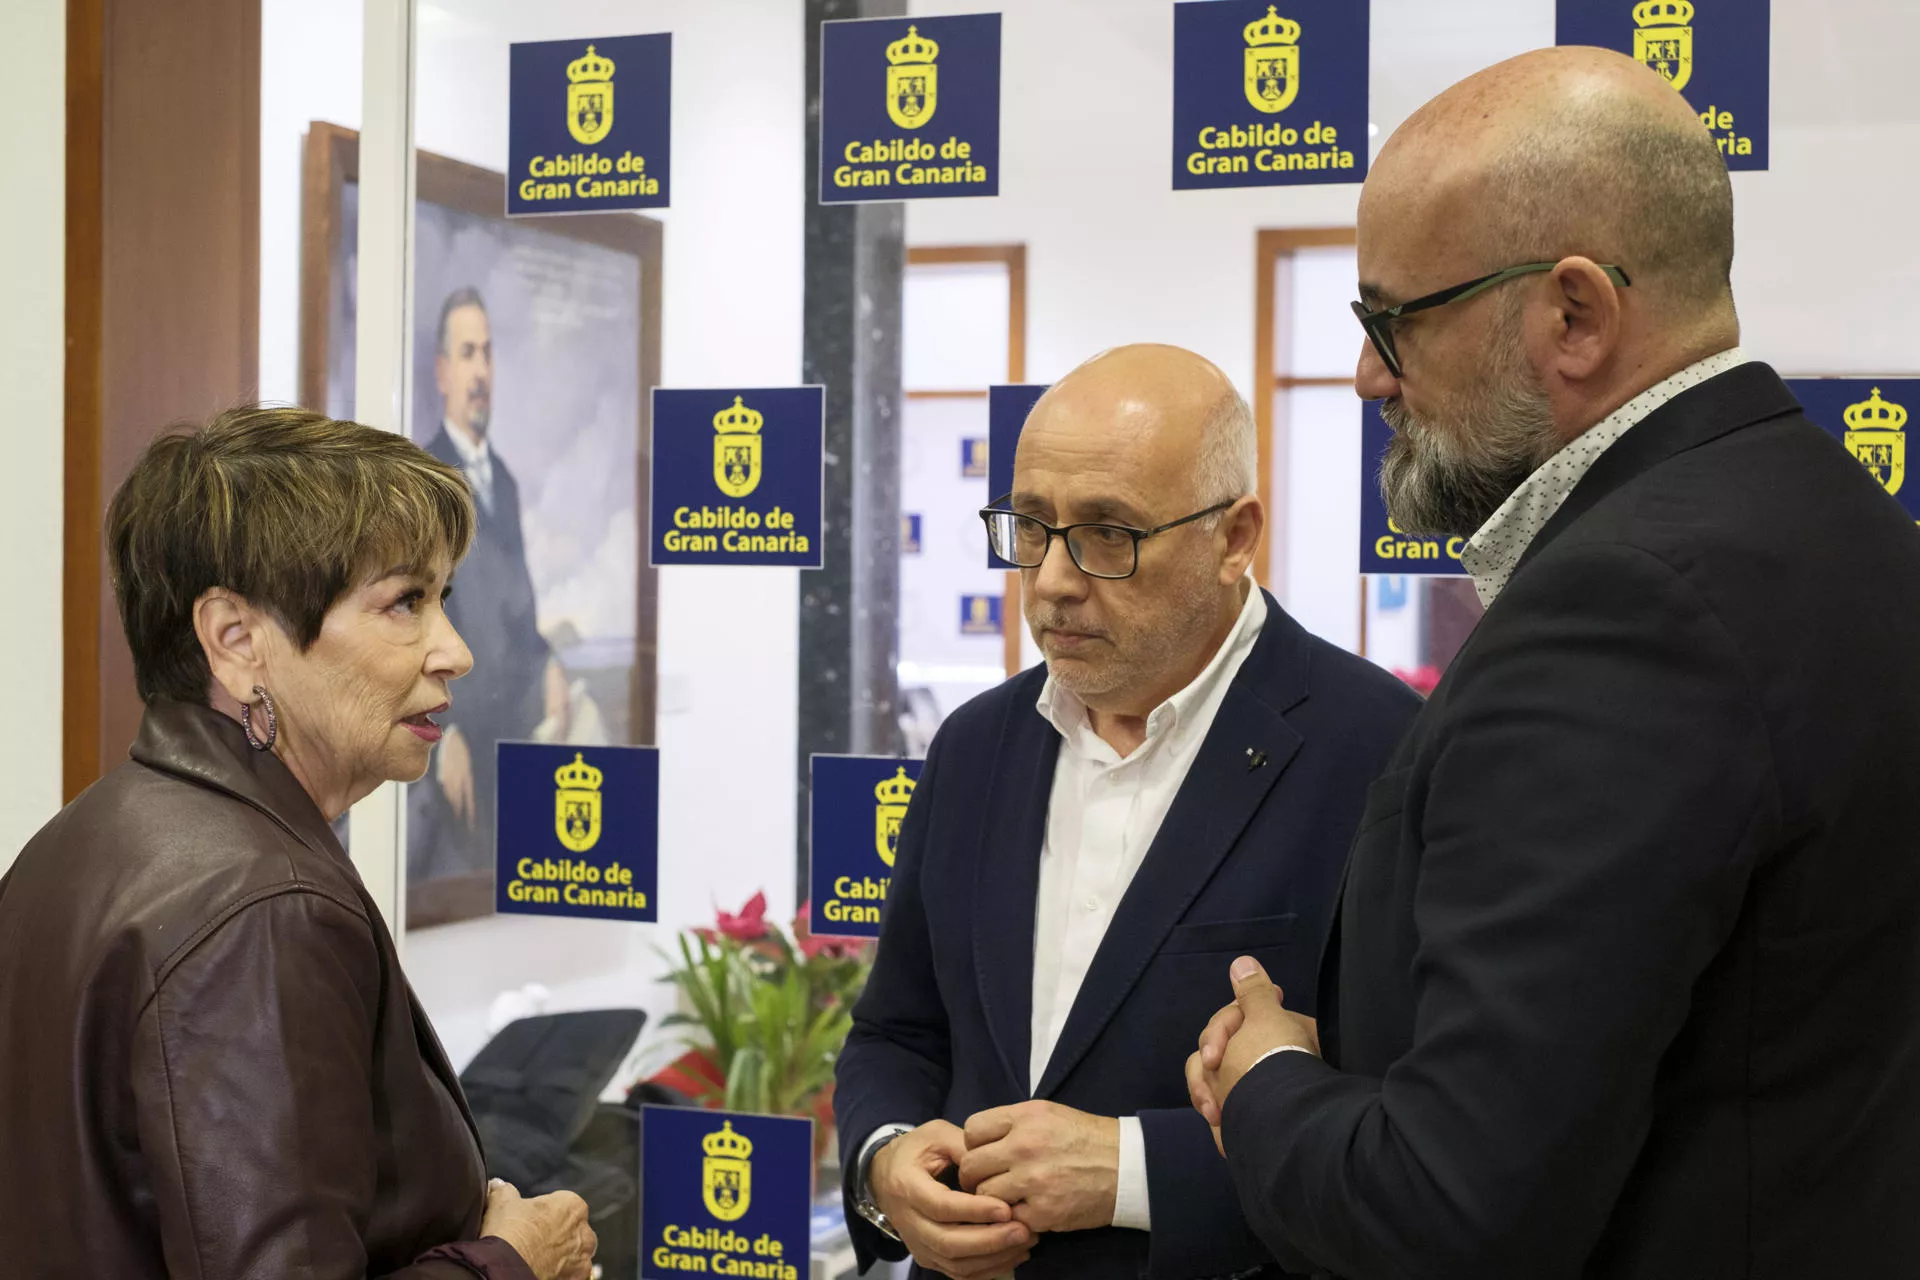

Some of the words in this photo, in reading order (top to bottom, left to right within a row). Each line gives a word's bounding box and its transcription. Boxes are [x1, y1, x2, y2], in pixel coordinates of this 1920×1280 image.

[1699, 105, 1733, 129] de
[1199, 122, 1298, 149] Cabildo
[1303, 121, 1337, 145] de
[844, 138, 936, 163] Cabildo
[940, 136, 971, 159] de
[1187, 152, 1248, 175] Gran
[1255, 145, 1354, 172] Canaria
[529, 152, 613, 177] Cabildo
[616, 151, 645, 173] de
[834, 166, 890, 187] Gran
[895, 160, 986, 185] Canaria
[519, 179, 571, 200] Gran
[575, 173, 659, 198] Canaria
[674, 506, 760, 529] Cabildo
[765, 506, 794, 529] de
[664, 530, 717, 552] Gran
[722, 530, 809, 552] Canaria
[1375, 536, 1439, 559] Gran
[517, 858, 600, 883] Cabildo
[604, 862, 632, 885] de
[508, 880, 559, 903] Gran
[564, 883, 646, 908] Canaria
[824, 900, 880, 923] Gran
[664, 1225, 749, 1253] Cabildo
[754, 1234, 782, 1257] de
[653, 1247, 706, 1271] Gran
[711, 1253, 797, 1280] Canaria
